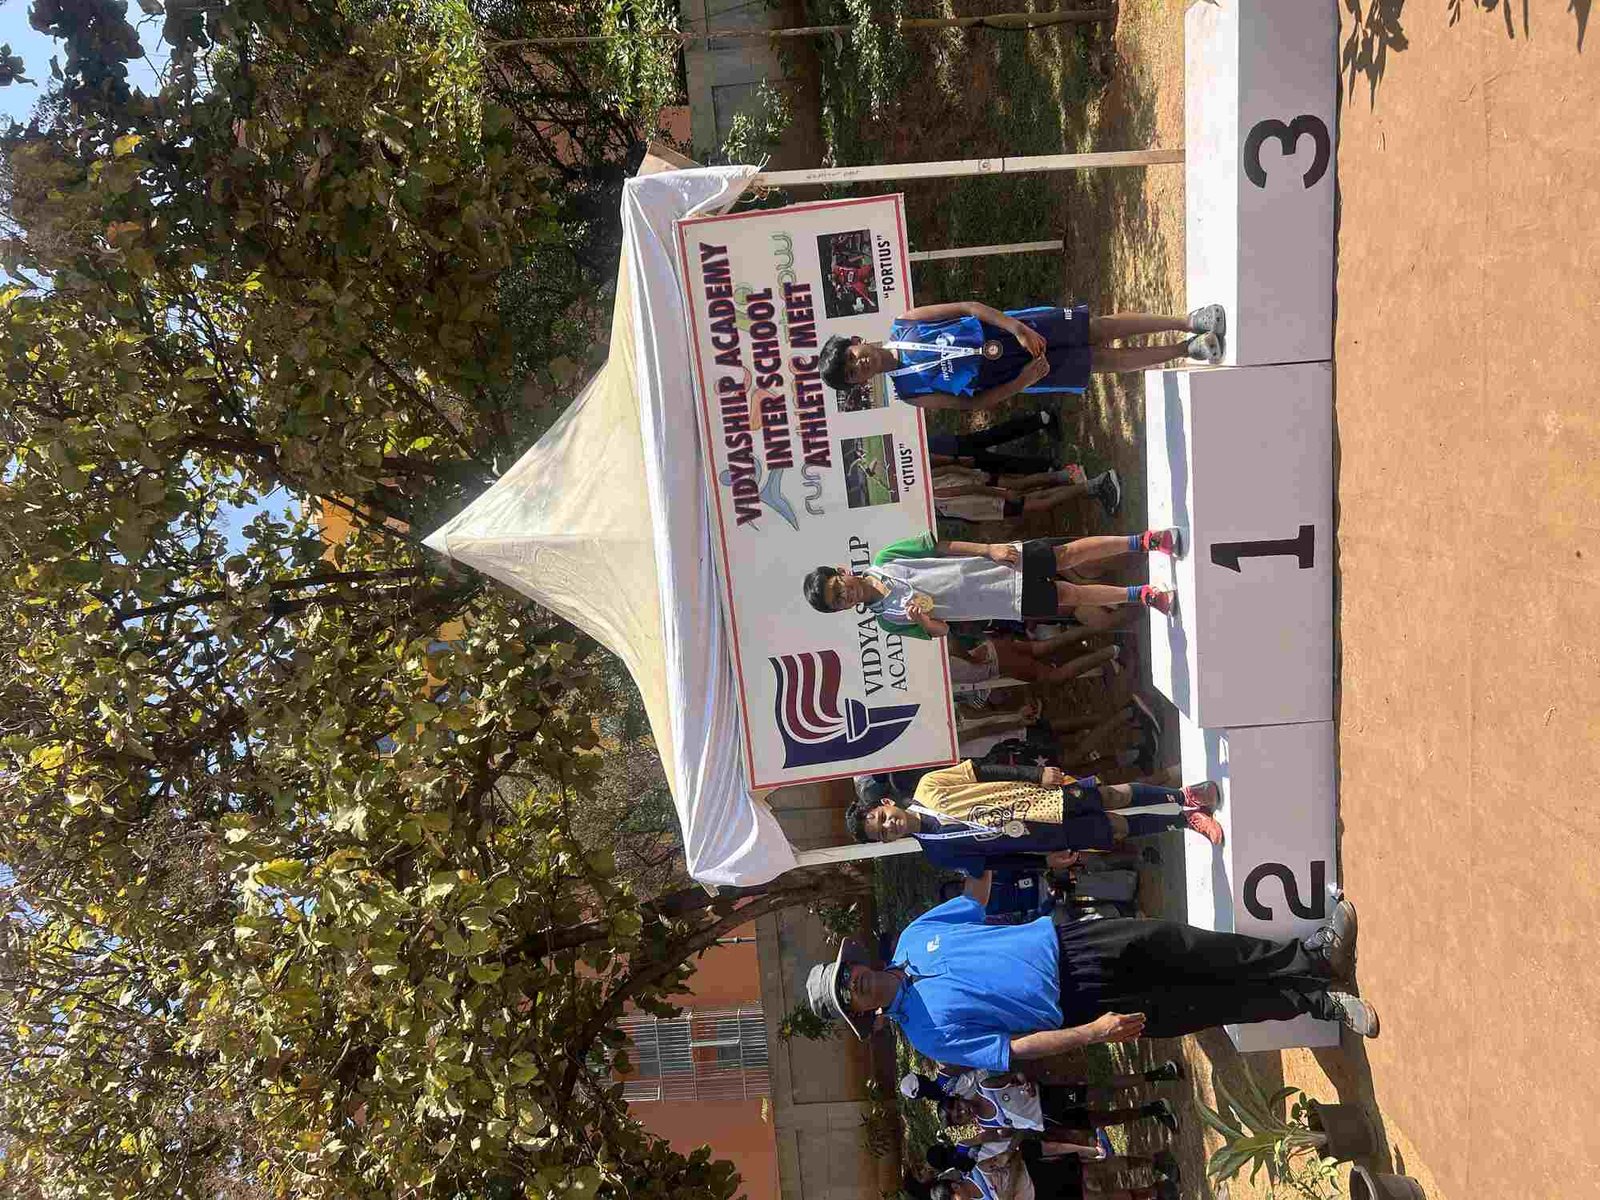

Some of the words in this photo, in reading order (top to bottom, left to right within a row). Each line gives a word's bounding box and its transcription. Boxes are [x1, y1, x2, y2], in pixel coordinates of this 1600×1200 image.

[1243, 114, 1331, 189] 3
[699, 242, 742, 368] ACADEMY
[746, 288, 784, 388] SCHOOL
[784, 282, 818, 348] MEET
[759, 394, 793, 470] INTER
[793, 355, 831, 468] ATHLETIC
[717, 376, 762, 526] VIDYASHILP
[1210, 524, 1315, 573] 1
[848, 536, 884, 697] VIDYASILP
[886, 633, 908, 692] ACAD
[1242, 860, 1326, 921] 2
